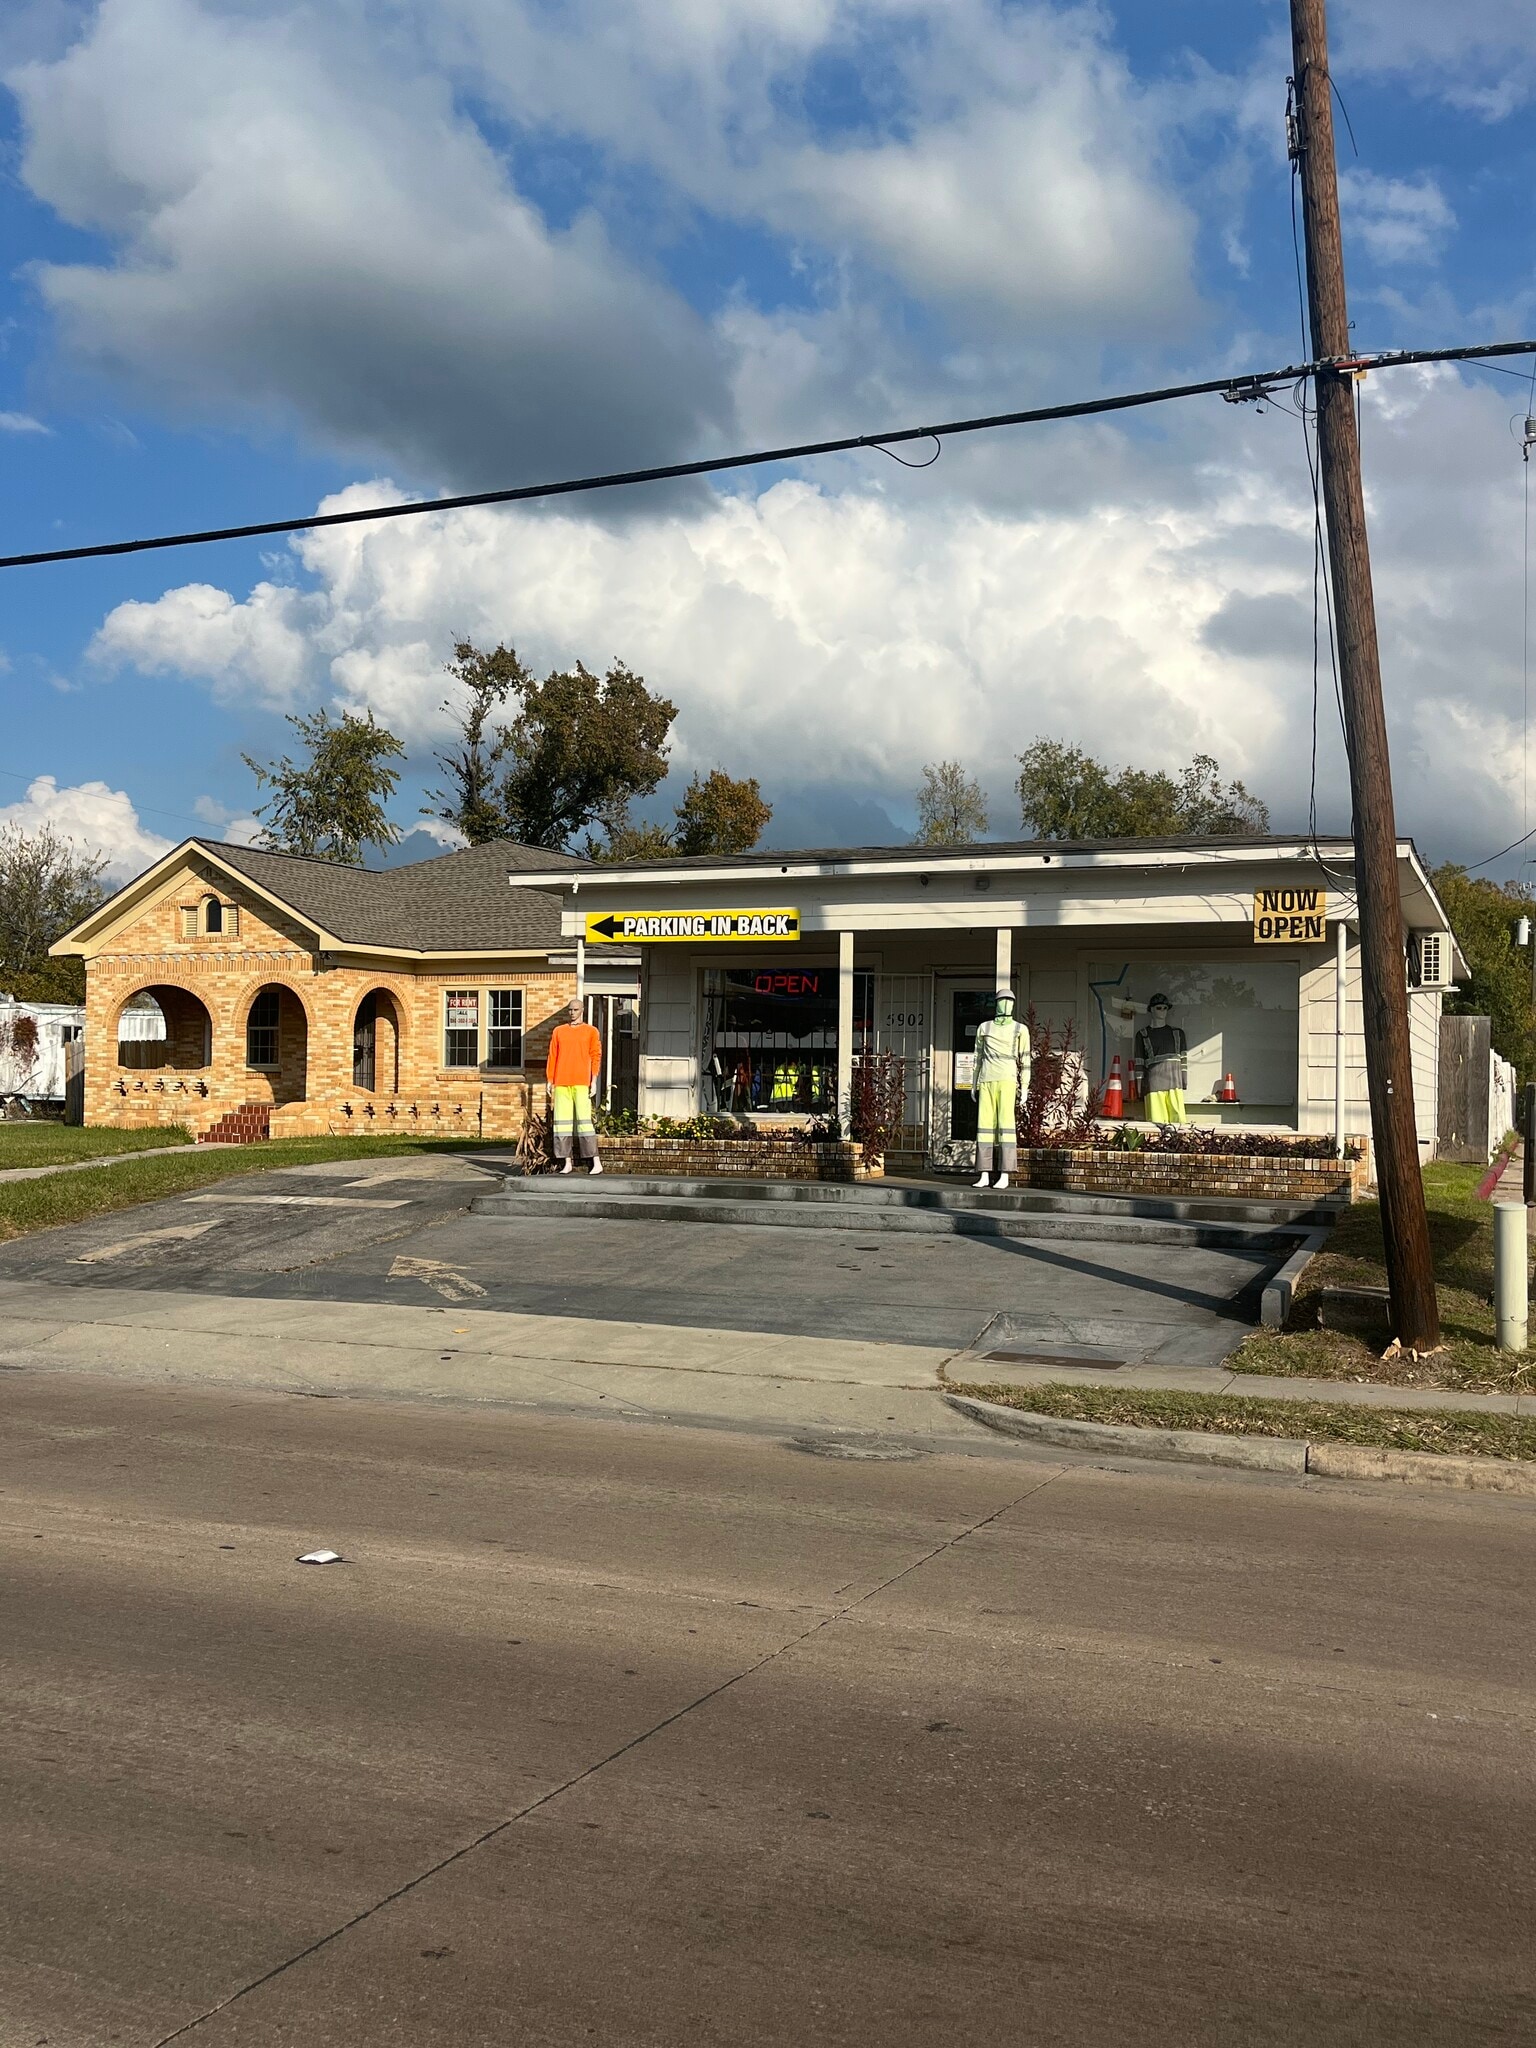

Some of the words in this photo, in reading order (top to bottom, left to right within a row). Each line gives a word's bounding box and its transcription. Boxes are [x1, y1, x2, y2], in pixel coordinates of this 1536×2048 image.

[1262, 889, 1319, 912] NOW
[623, 916, 705, 936] PARKING
[710, 916, 732, 935] IN
[737, 915, 790, 935] BACK
[1259, 916, 1323, 939] OPEN
[755, 976, 819, 993] OPEN
[886, 1013, 924, 1027] 5902
